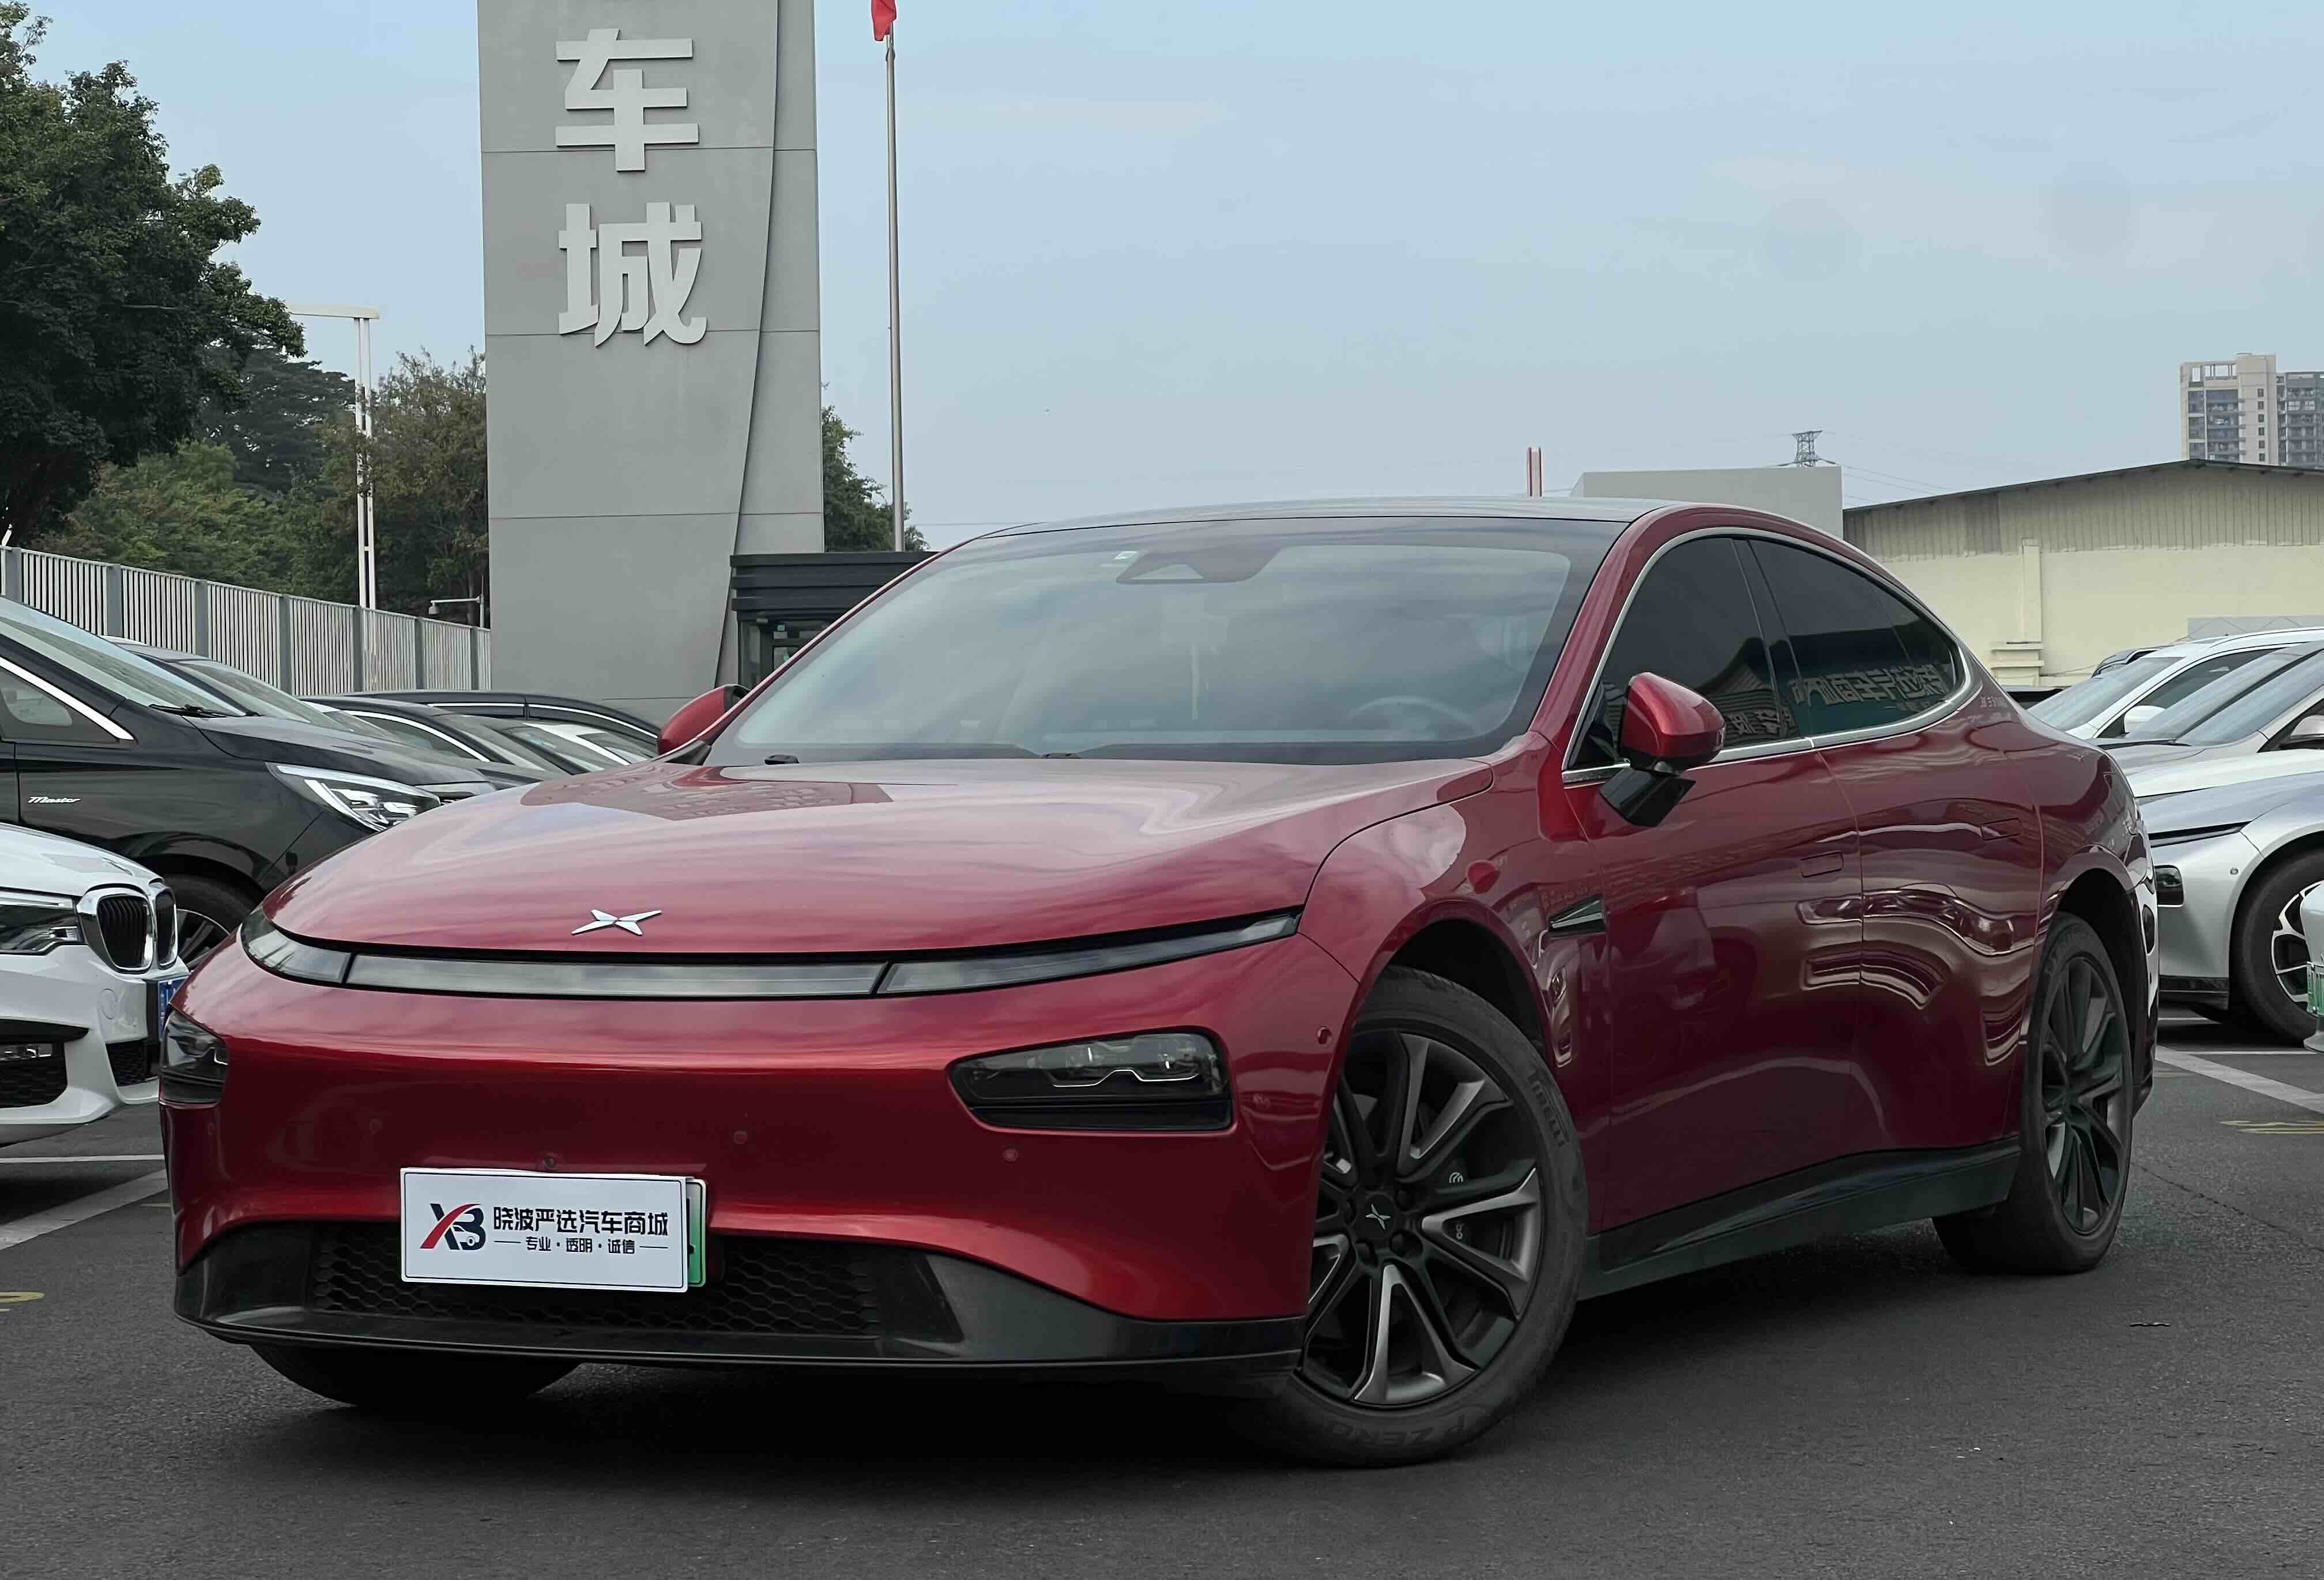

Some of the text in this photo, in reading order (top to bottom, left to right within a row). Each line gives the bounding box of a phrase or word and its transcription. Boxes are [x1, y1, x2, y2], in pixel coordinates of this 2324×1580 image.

[554, 28, 707, 347] 车城
[493, 1206, 669, 1236] 晓波严选汽车商城
